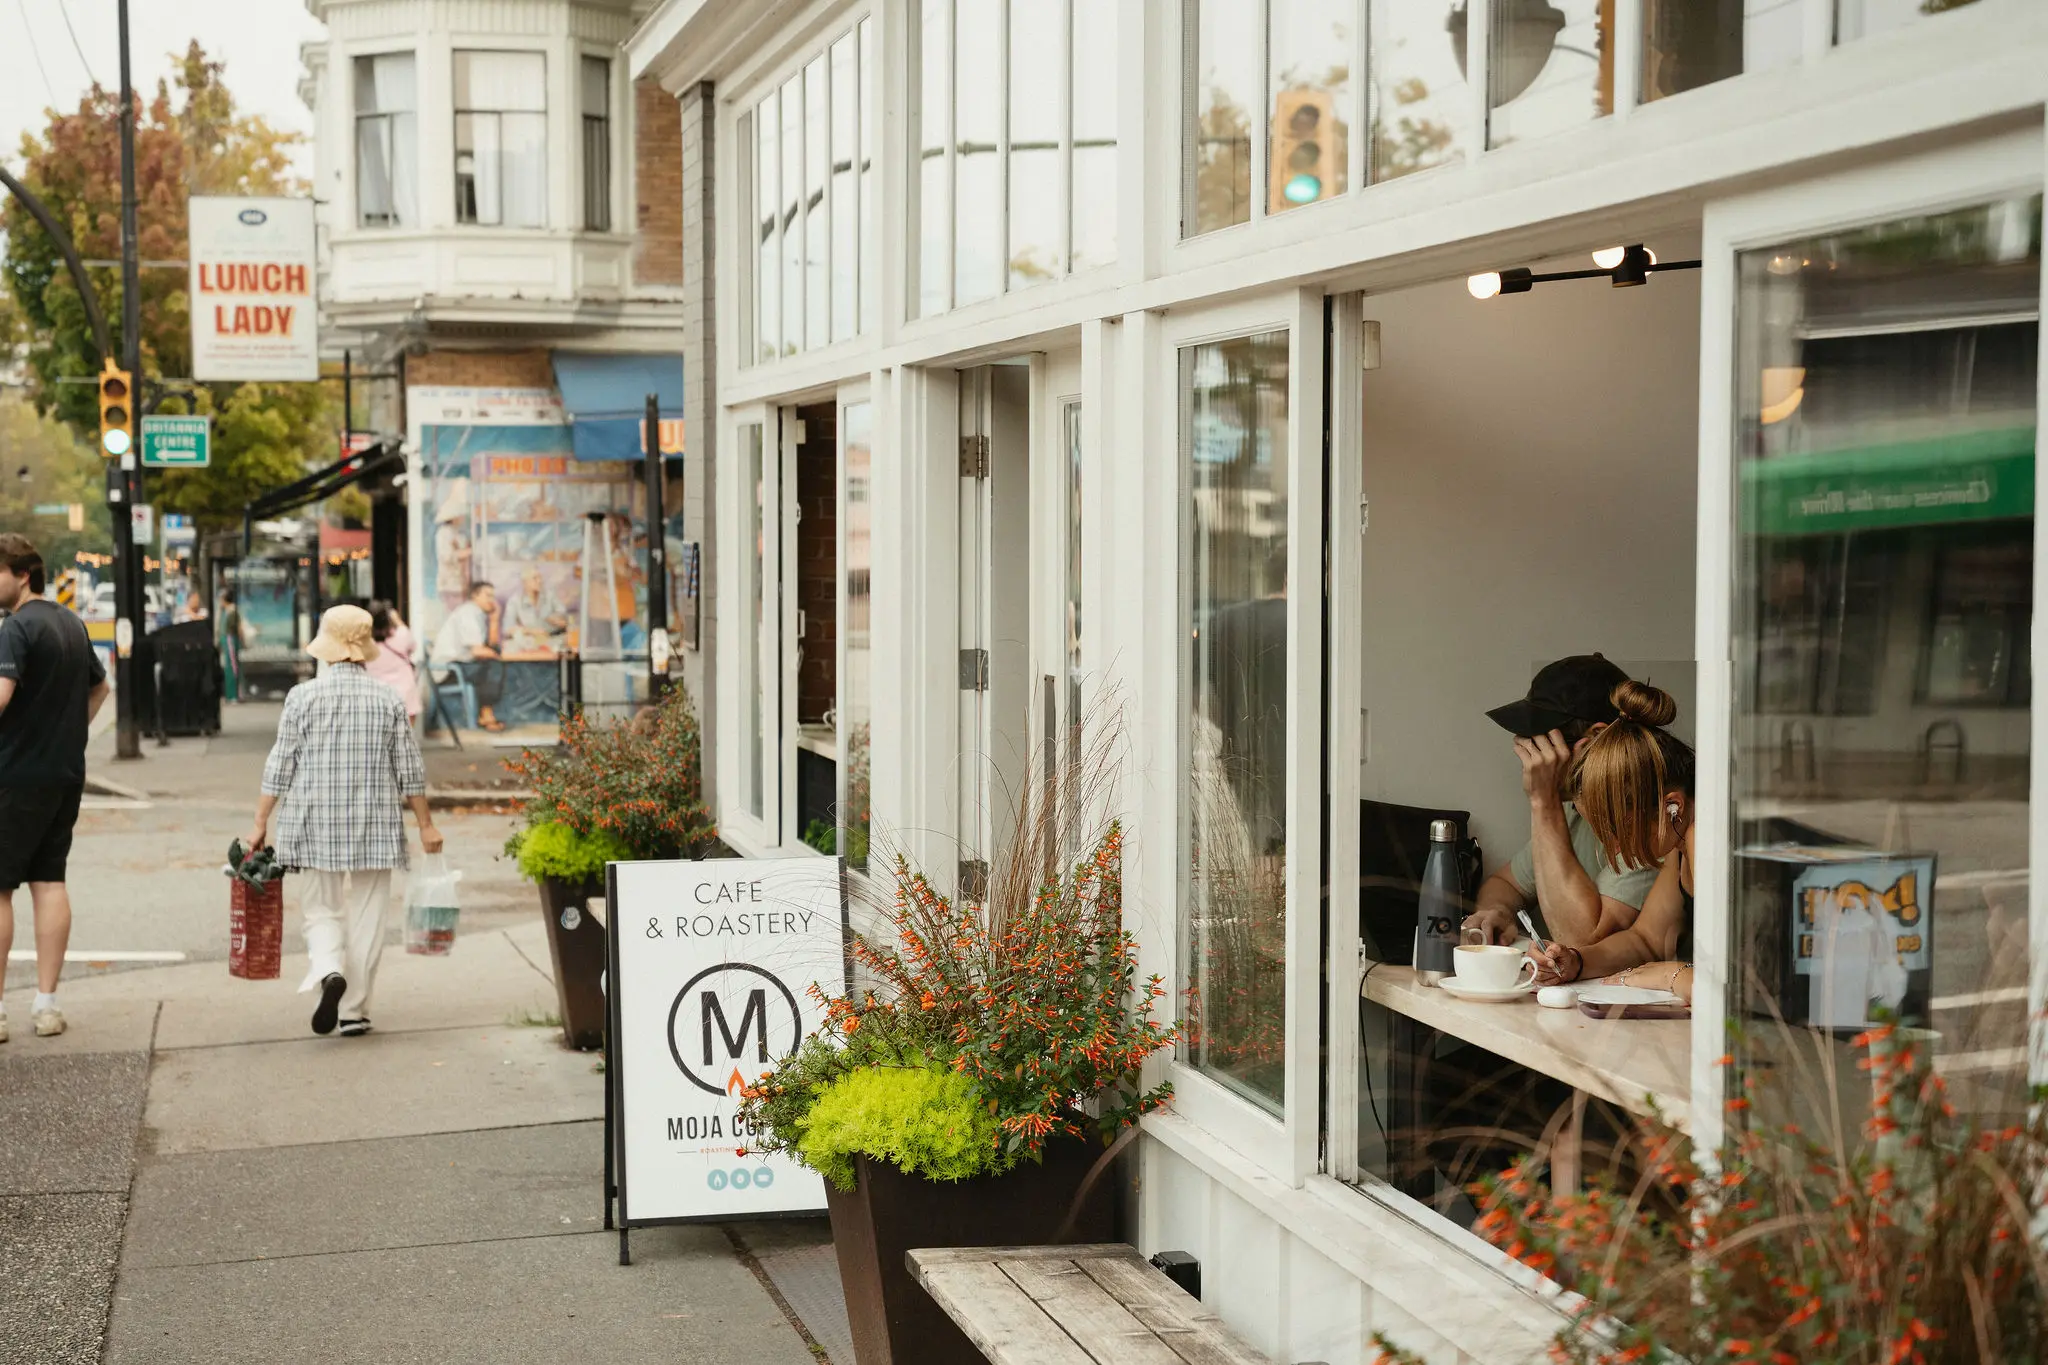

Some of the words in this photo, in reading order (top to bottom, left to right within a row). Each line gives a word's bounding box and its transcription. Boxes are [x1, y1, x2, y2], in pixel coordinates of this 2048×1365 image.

[198, 262, 309, 296] LUNCH
[214, 304, 295, 338] LADY
[144, 422, 205, 434] BRITANNIA
[694, 881, 763, 905] CAFE
[646, 917, 664, 939] &
[676, 911, 814, 938] ROASTERY
[701, 988, 769, 1067] M
[667, 1115, 723, 1141] MOJA
